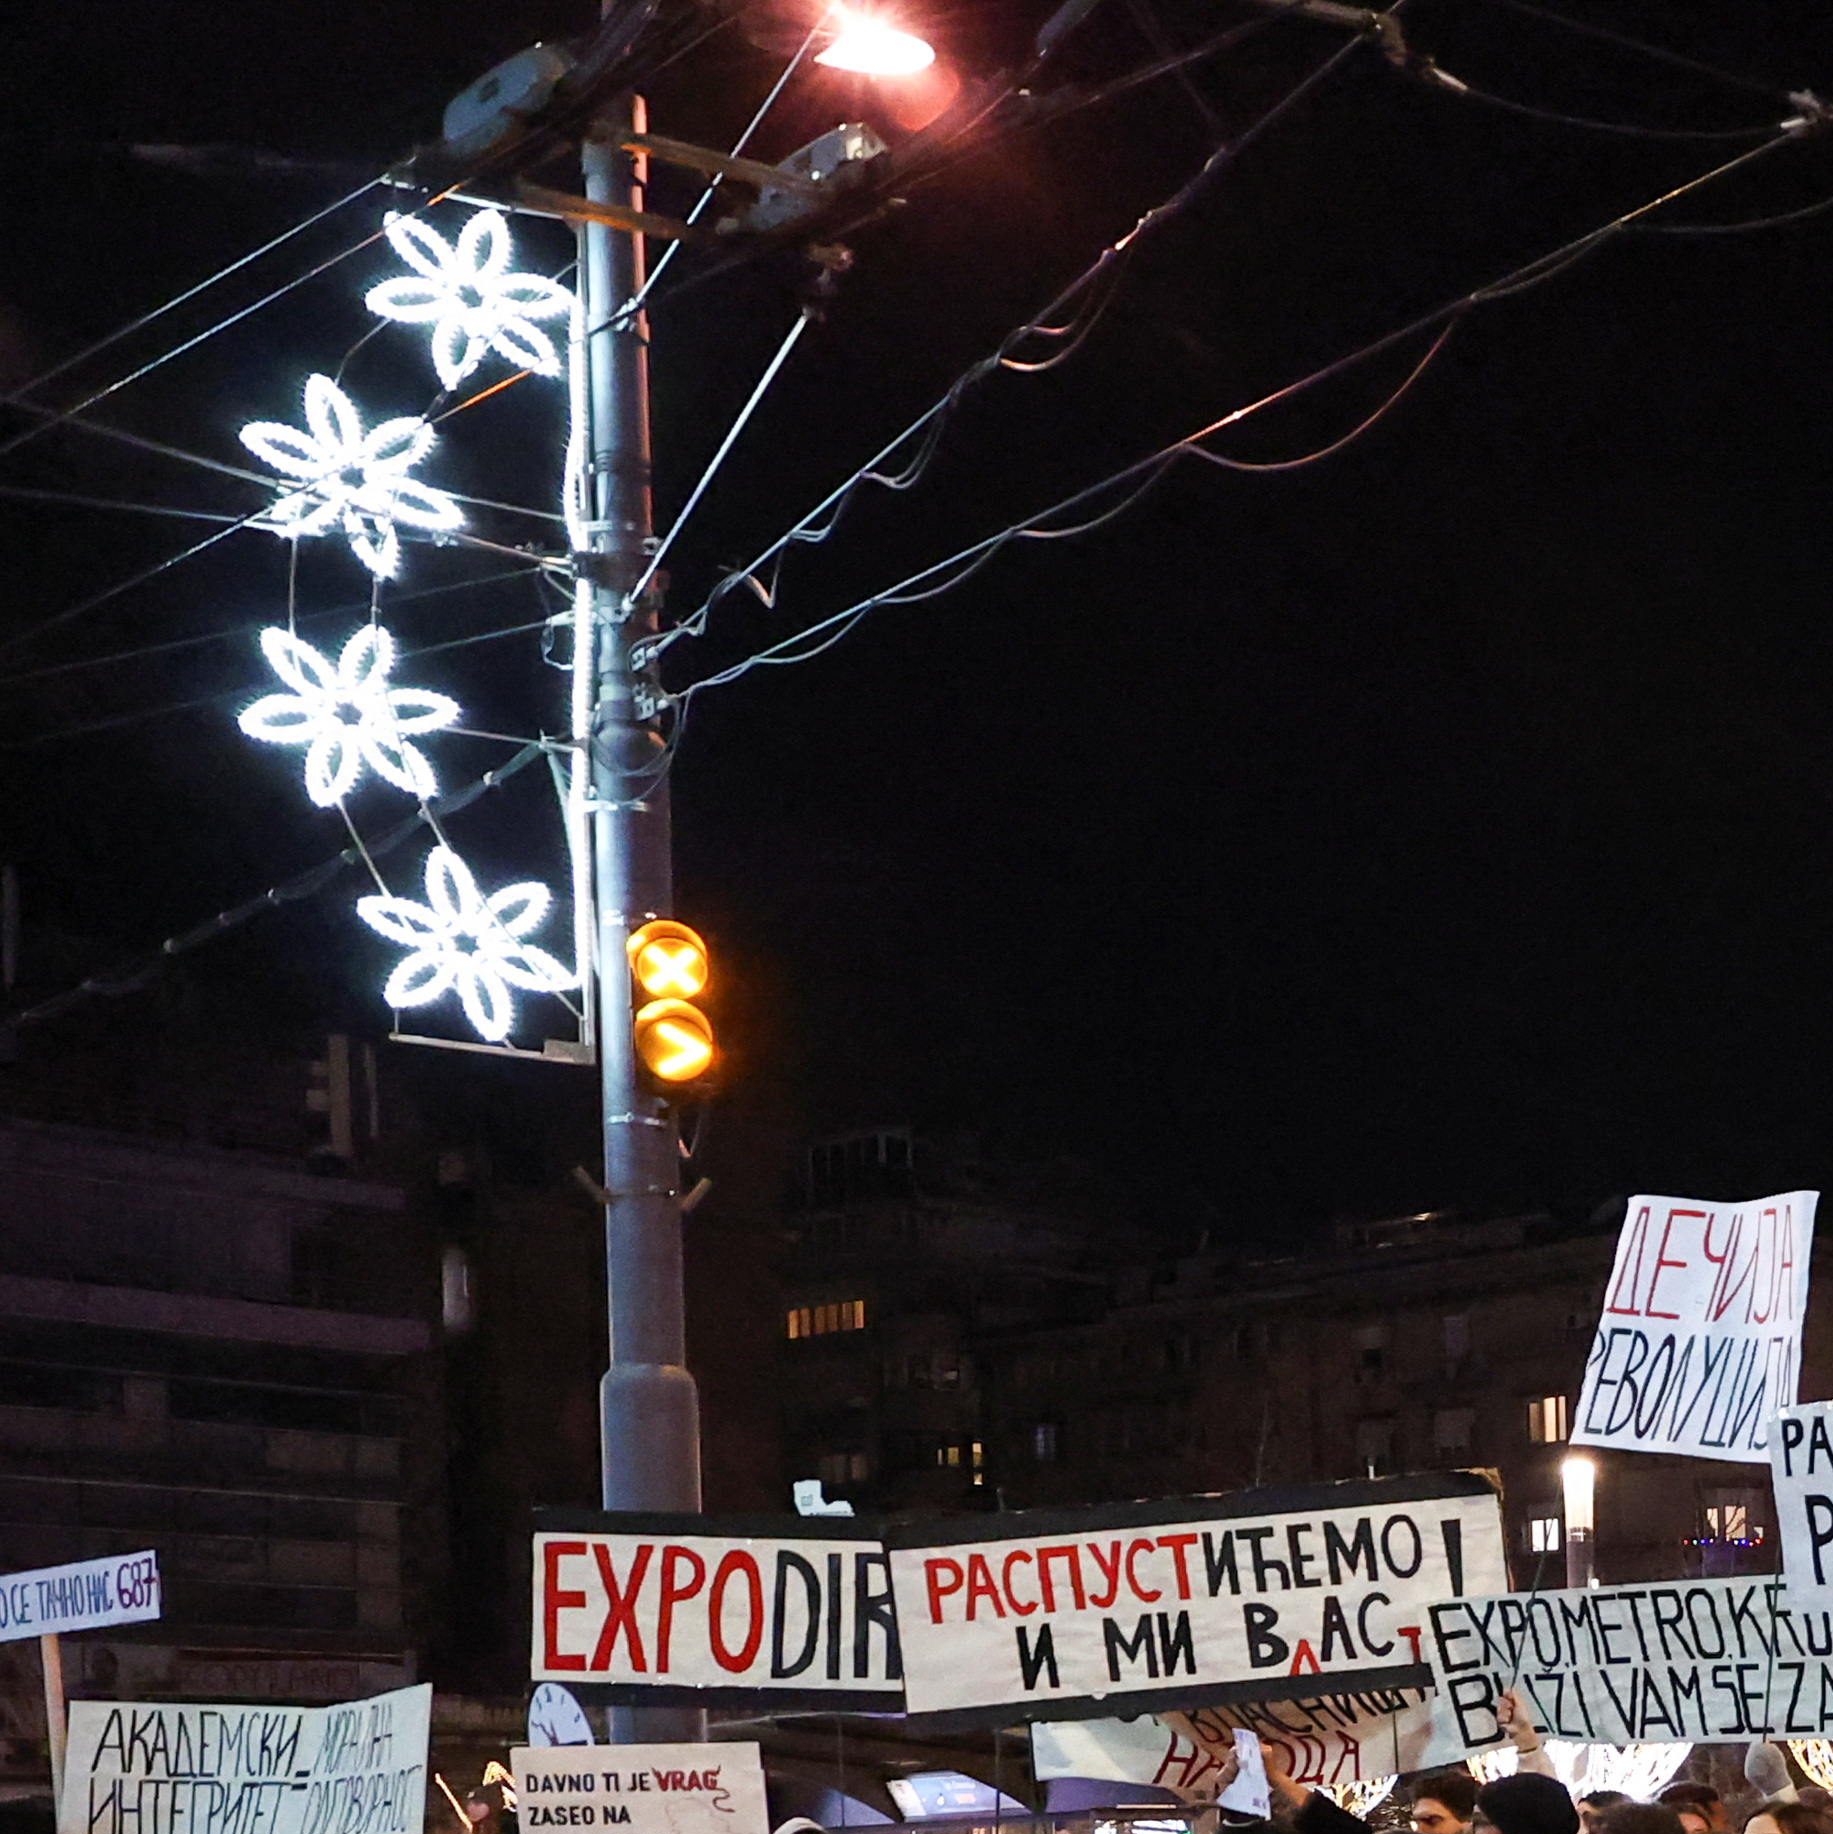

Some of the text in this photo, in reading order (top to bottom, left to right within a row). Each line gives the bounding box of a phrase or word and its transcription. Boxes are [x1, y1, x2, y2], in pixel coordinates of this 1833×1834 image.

[1606, 1204, 1793, 1324] ДЕЧИЈА
[1016, 1623, 1060, 1690] И
[1102, 1610, 1196, 1682] МИ
[1600, 1665, 1708, 1738] VAM
[1712, 1664, 1776, 1734] SE
[91, 1708, 303, 1778] АКАДЕМСКИ
[1153, 1730, 1361, 1788] НАОДА
[525, 1768, 720, 1793] DAVNO TI JE VRAG
[528, 1805, 631, 1826] ZASEO NA
